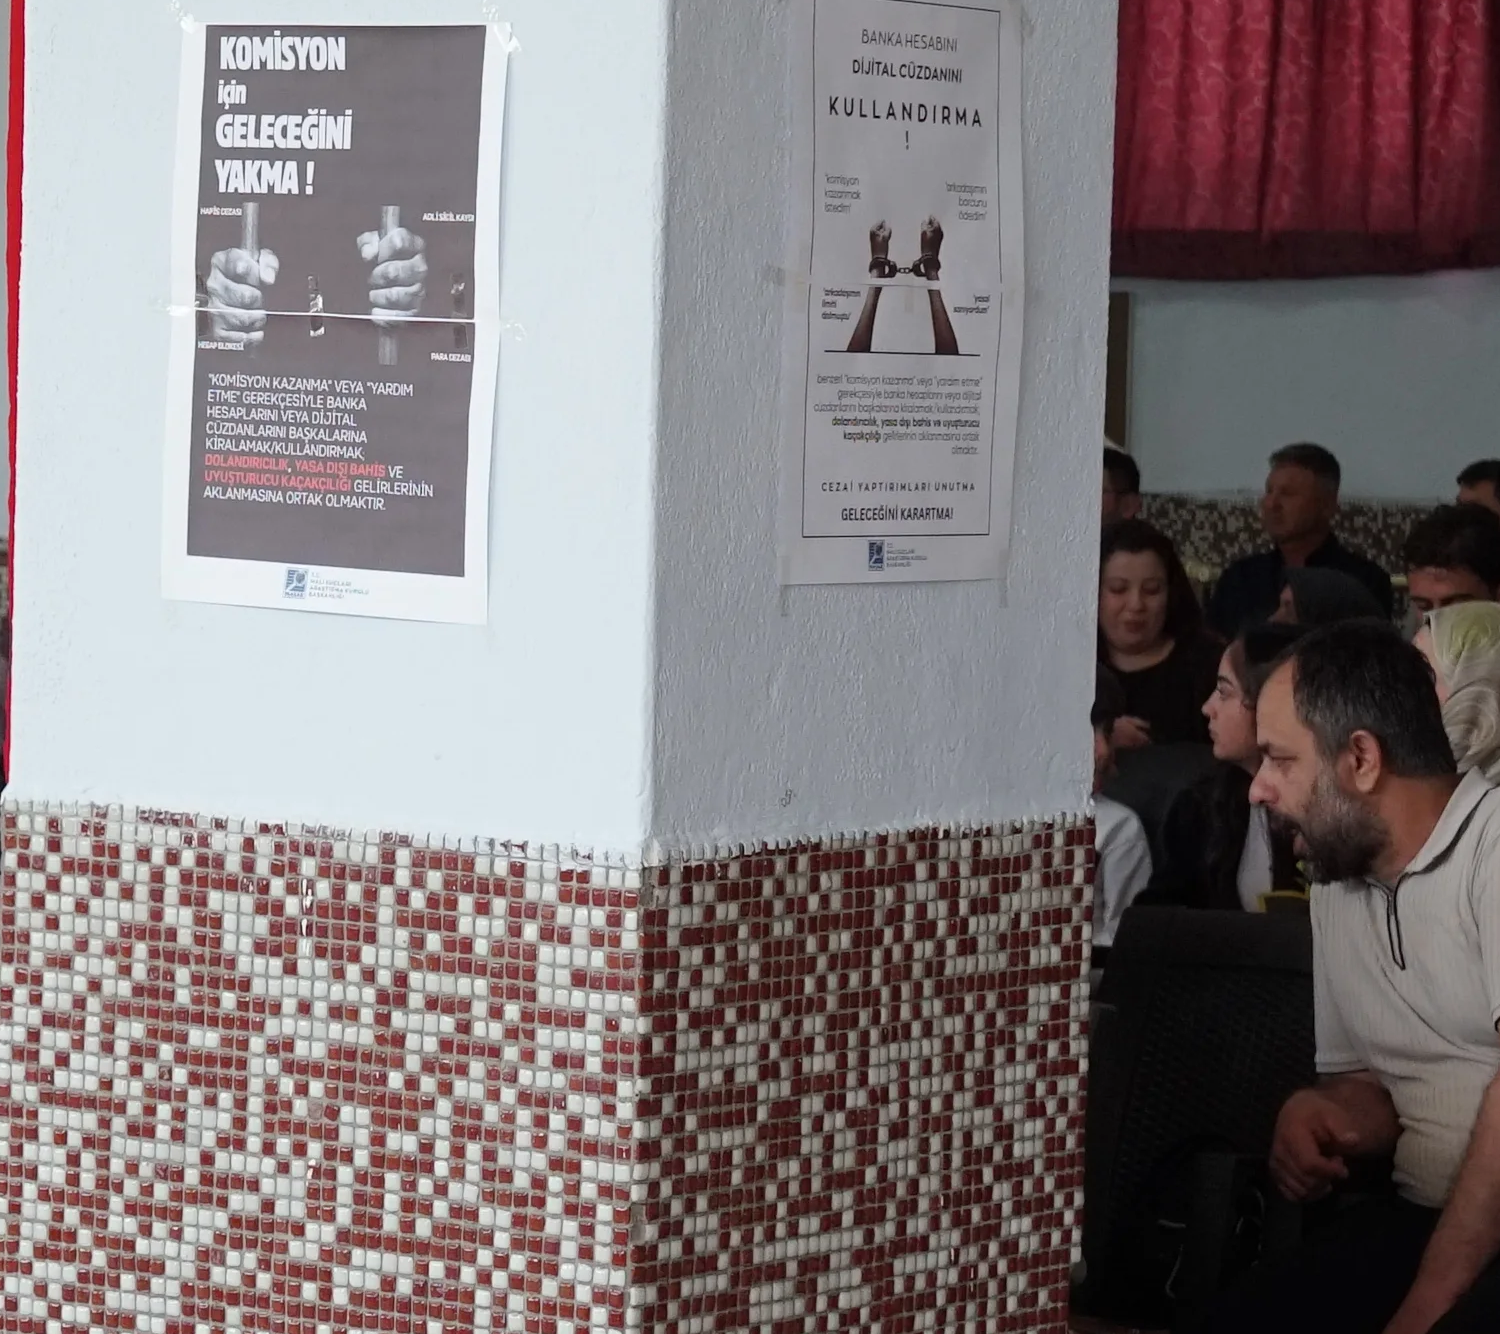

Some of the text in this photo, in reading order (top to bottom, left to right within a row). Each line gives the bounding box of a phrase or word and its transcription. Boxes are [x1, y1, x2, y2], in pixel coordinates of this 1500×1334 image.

[220, 30, 346, 71] KOMİSYON
[861, 29, 958, 53] BANKA HESABINI
[852, 57, 963, 83] DİJİTAL CÜZDANINI
[217, 79, 247, 109] için
[829, 96, 982, 127] KULLANDIRMA
[215, 108, 352, 150] GELECEĞİNİ
[214, 159, 315, 195] YAKMA !
[334, 380, 364, 394] VEYA
[242, 391, 324, 409] GEREKÇESİYLE
[326, 396, 367, 411] BANKA
[207, 406, 357, 427] HESAPLARINI VEYA DİJİTAL
[206, 421, 367, 444] CÜZDANLARINI BAŞKALARINA
[204, 454, 404, 479] DOLANDIRICILIK, YASA DIŞI BAHİS VE
[204, 471, 434, 496] UYUŞTURUCU KAÇAKÇILIĞI GELİRLERİNİN
[821, 480, 975, 492] CEZAİ YAPTIRIMLARI UNUTMA
[203, 487, 386, 510] AKLANMASINA ORTAK OLMAKTIR.
[841, 505, 899, 521] GELECEĞİNİ
